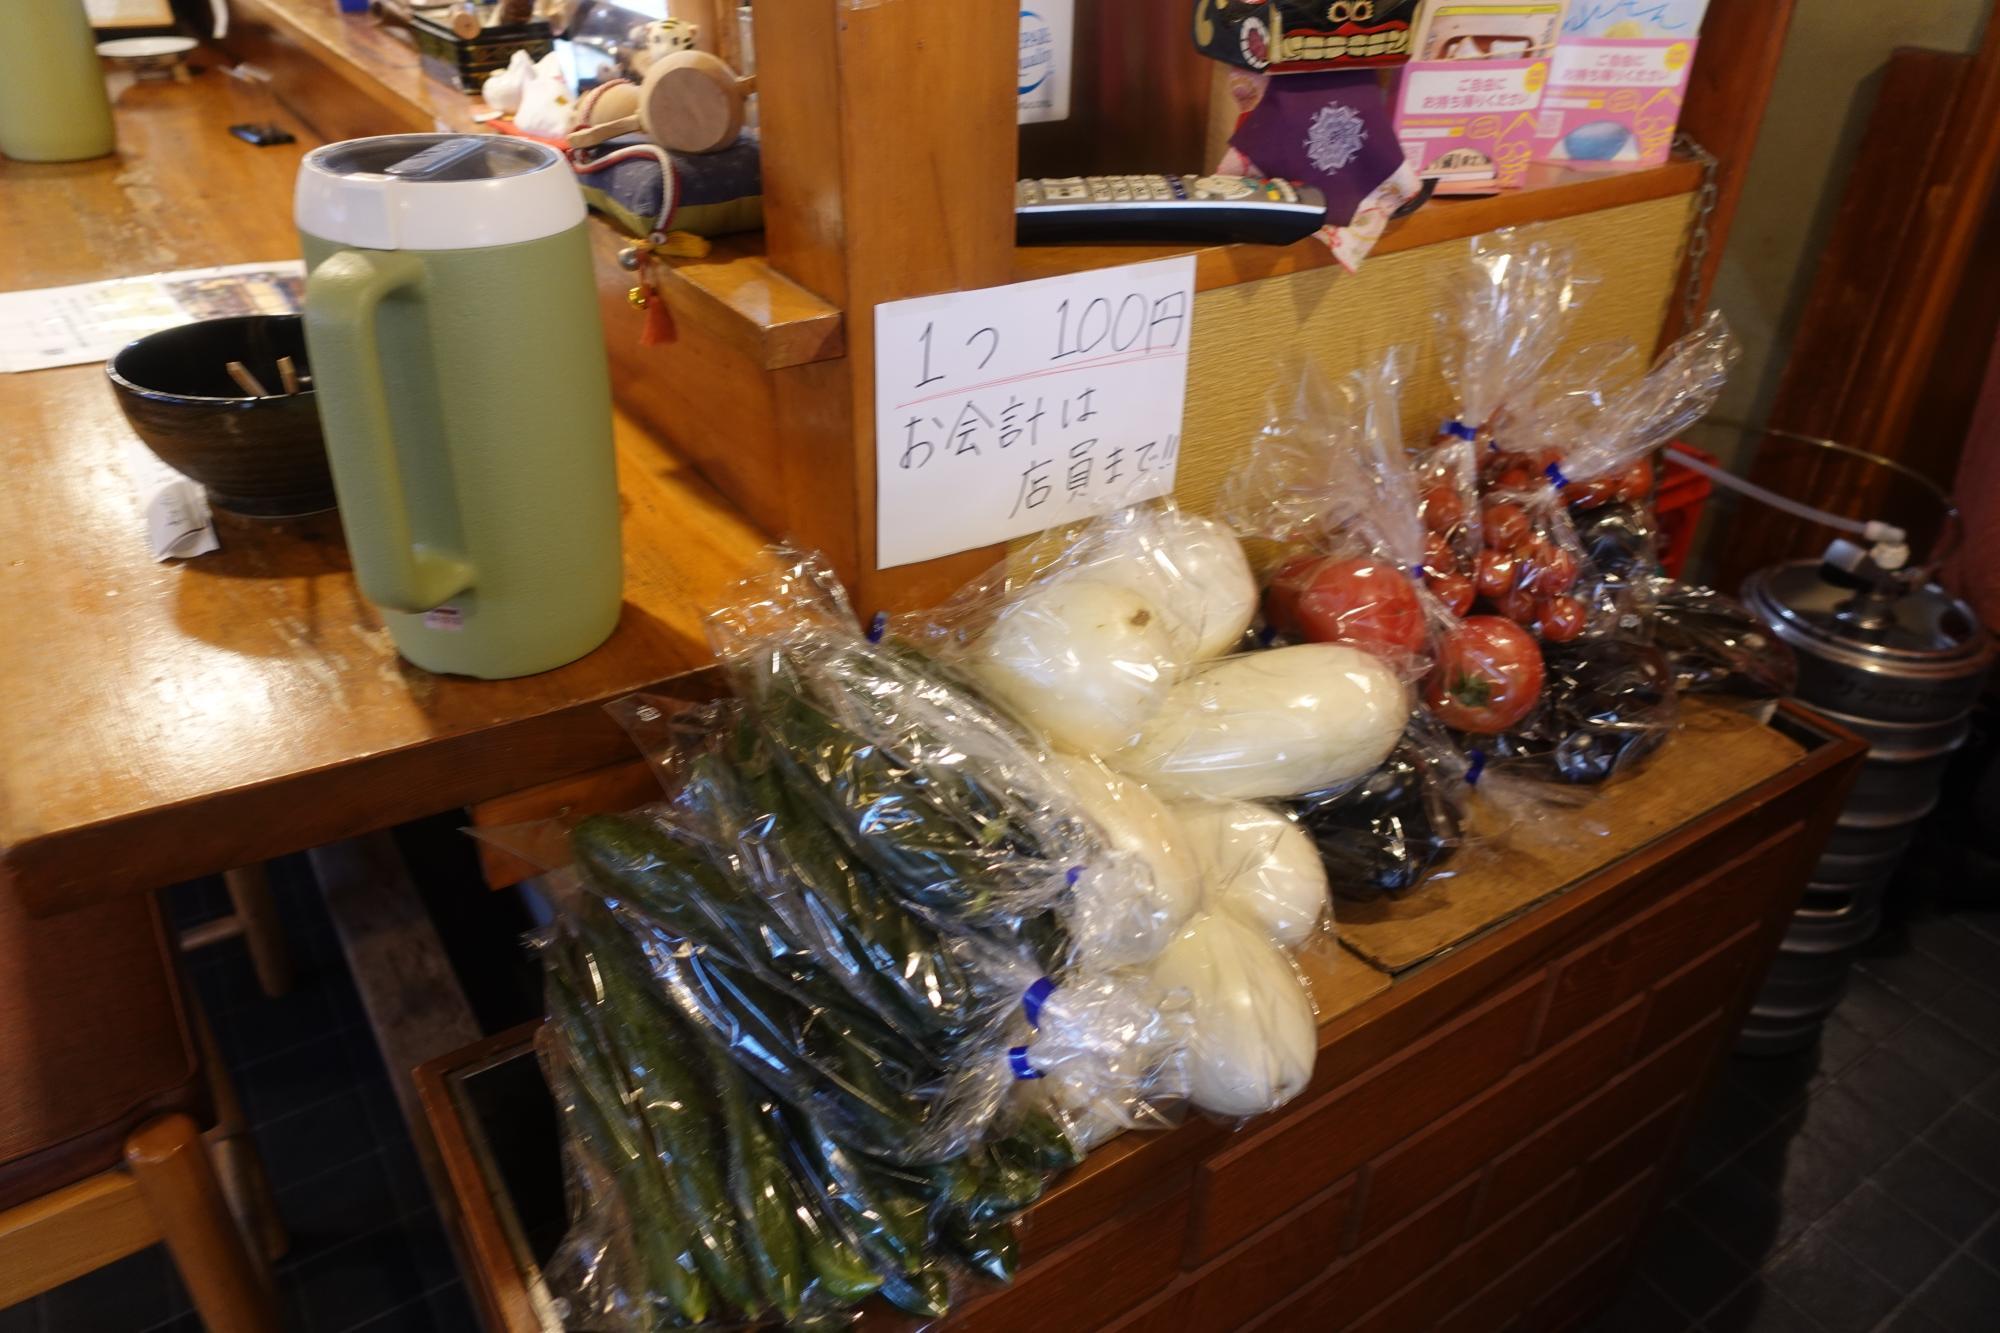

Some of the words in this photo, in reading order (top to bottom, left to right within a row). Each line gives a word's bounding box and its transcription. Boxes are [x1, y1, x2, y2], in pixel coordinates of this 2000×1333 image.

[1049, 290, 1187, 361] 100円
[899, 387, 1098, 469] お会計は
